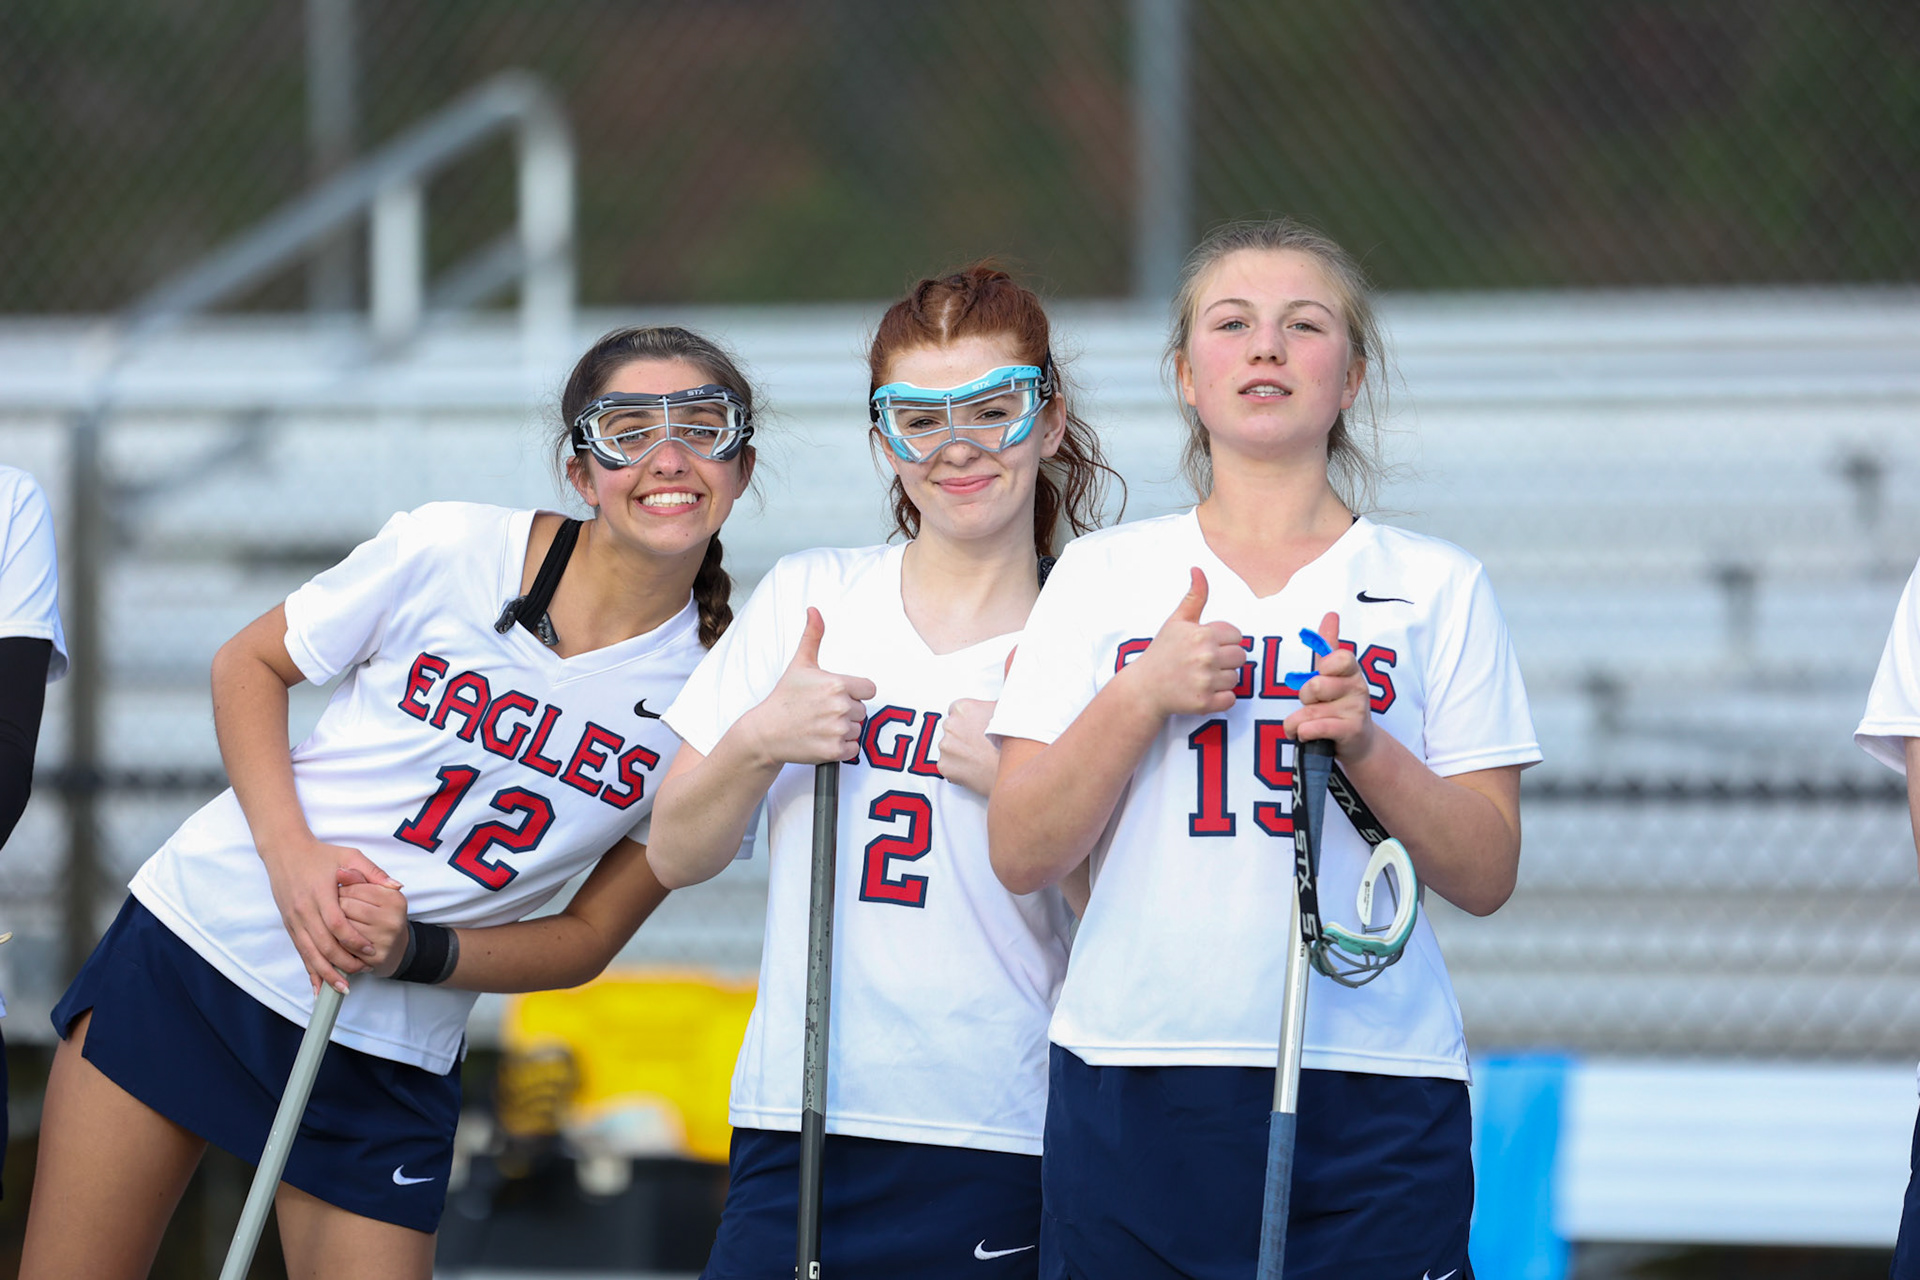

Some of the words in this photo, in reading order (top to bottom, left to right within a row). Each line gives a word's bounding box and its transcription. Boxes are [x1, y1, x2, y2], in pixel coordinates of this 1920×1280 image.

[971, 380, 990, 391] STX
[398, 652, 661, 810] EAGLES
[1188, 719, 1294, 837] 15
[393, 764, 556, 891] 12
[859, 789, 932, 908] 2
[1328, 772, 1362, 815] STX
[1295, 829, 1312, 893] STX
